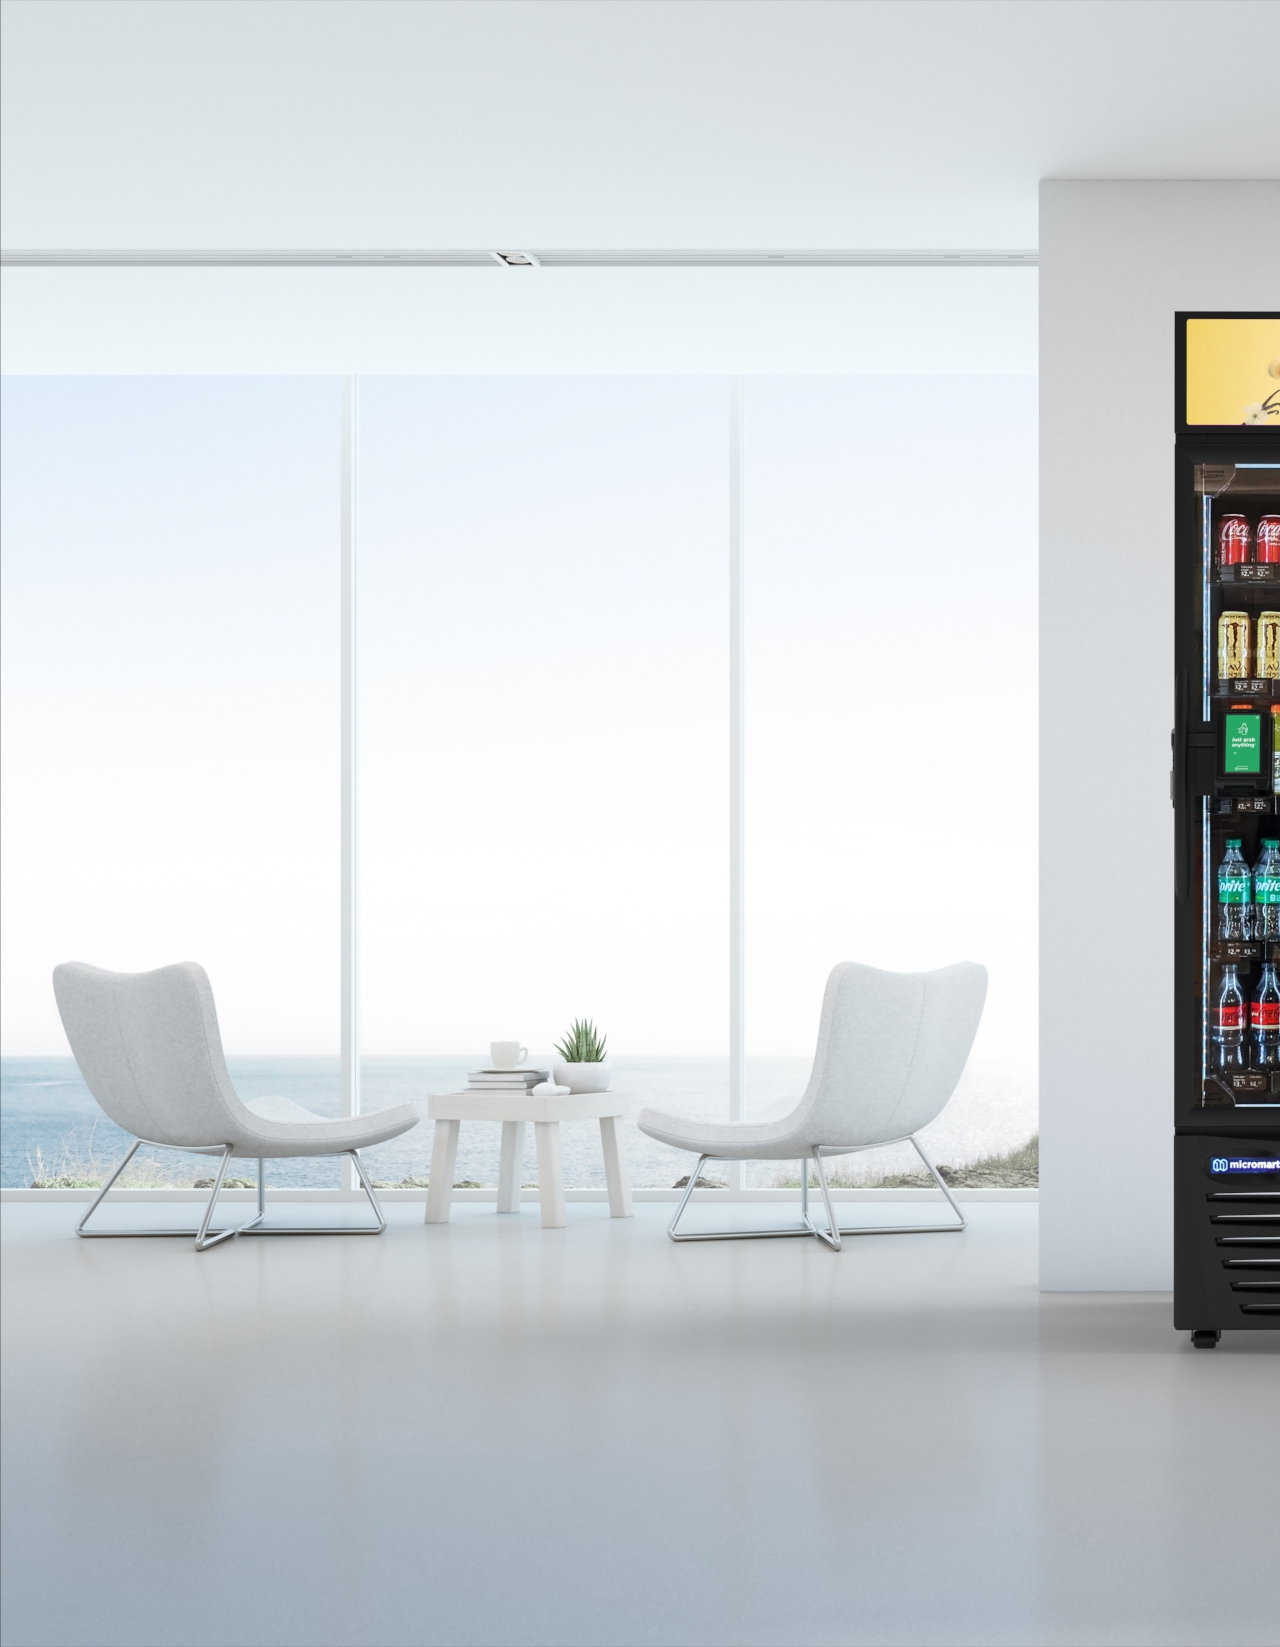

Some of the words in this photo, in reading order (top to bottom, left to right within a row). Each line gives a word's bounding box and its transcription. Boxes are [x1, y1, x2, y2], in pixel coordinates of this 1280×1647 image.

[1219, 879, 1245, 893] prite
[1256, 879, 1280, 893] prite
[1230, 1159, 1280, 1169] micromart
